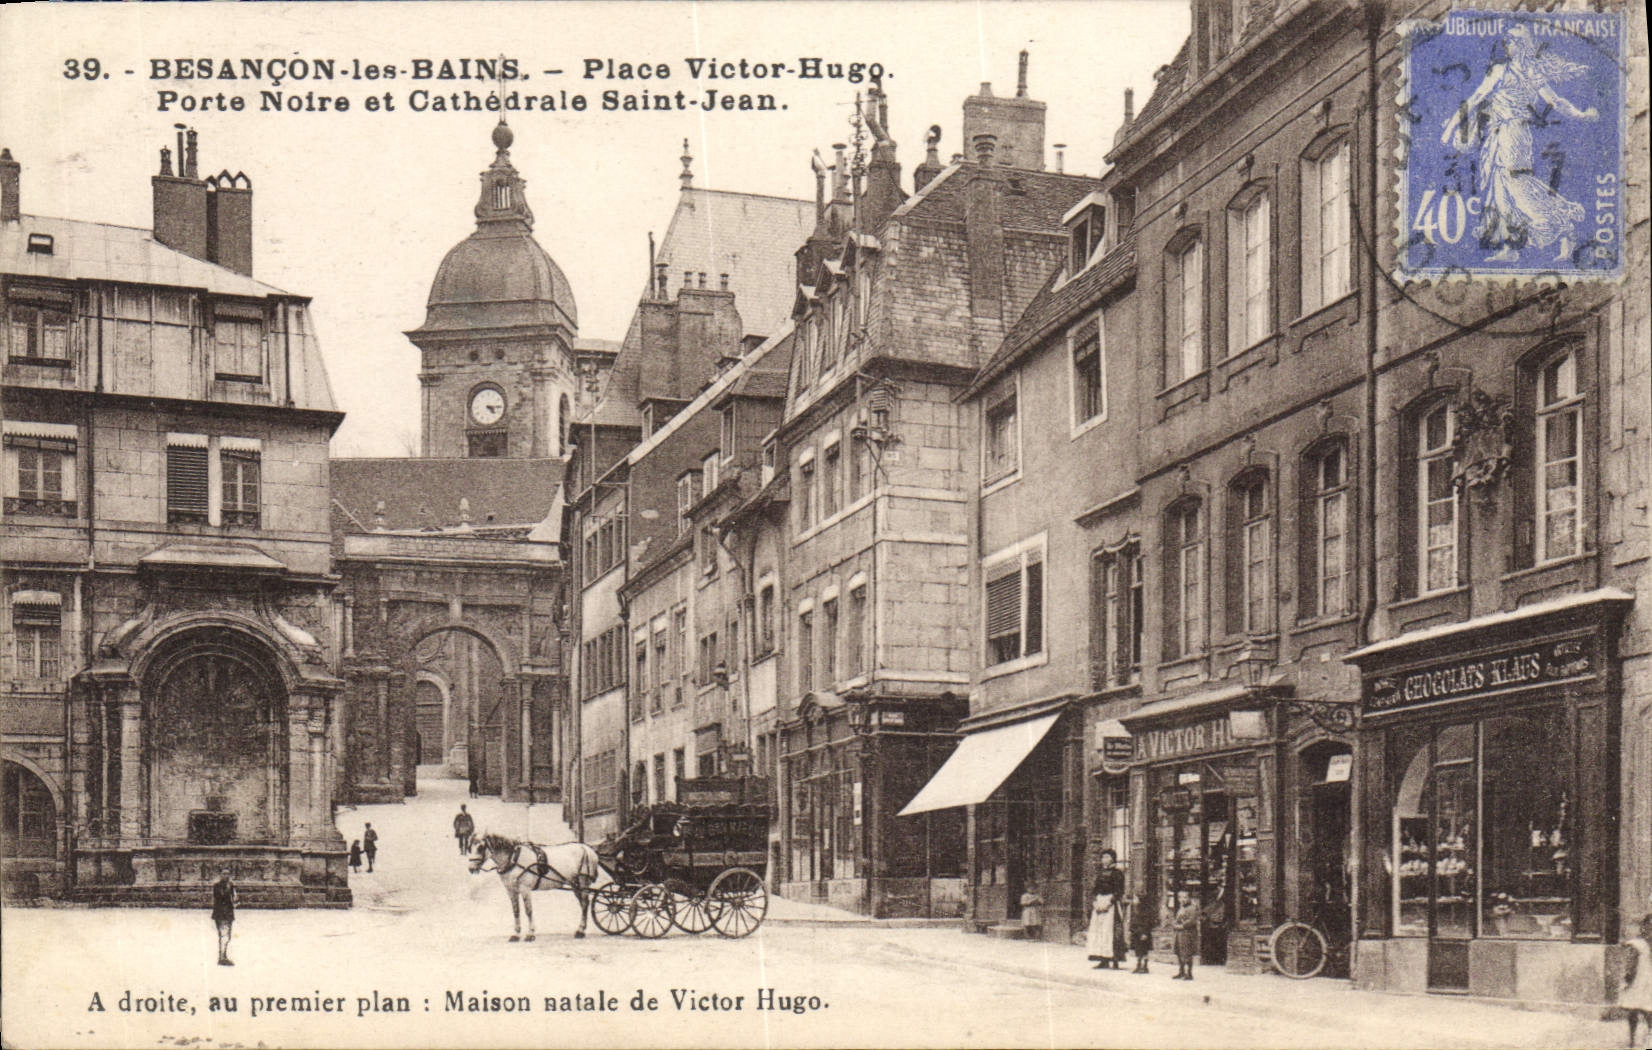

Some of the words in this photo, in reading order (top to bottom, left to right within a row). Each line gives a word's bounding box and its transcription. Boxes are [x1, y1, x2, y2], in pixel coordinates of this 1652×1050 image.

[1594, 171, 1617, 260] POSTES
[1404, 663, 1485, 702] CHOCOLATS
[1490, 652, 1541, 687] KLAUS
[1149, 724, 1205, 758] VICTOR
